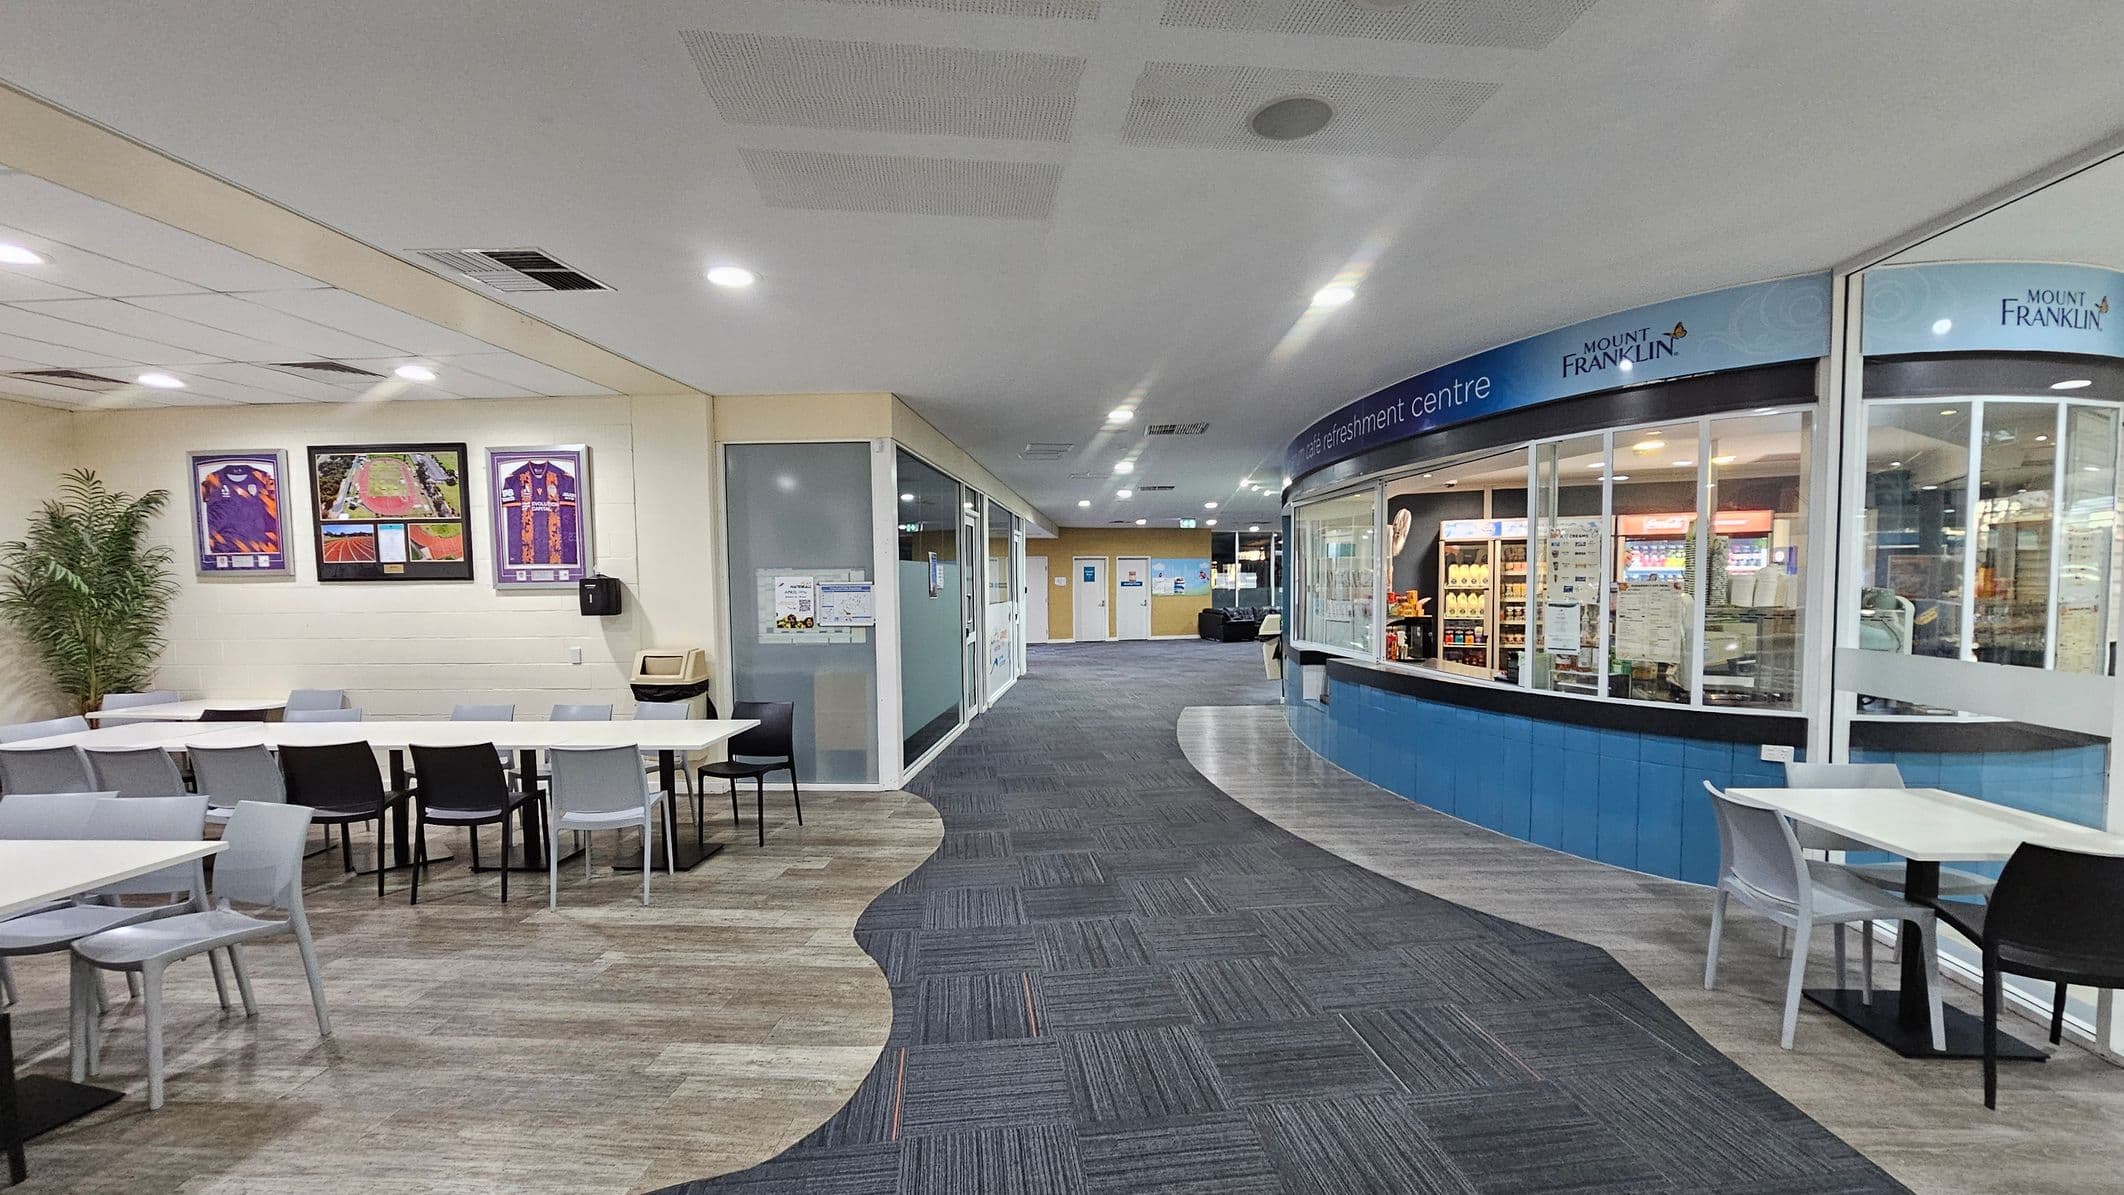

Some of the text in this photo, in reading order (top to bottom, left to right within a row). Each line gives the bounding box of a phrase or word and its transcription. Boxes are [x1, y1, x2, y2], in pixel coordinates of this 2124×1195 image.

[2027, 289, 2086, 306] MOUNT
[2001, 298, 2101, 330] FRANKLIN
[1583, 327, 1650, 355] MOUNT
[1562, 337, 1674, 378] FRANKLIN
[1305, 432, 1321, 460] café
[1323, 398, 1404, 450] refreshment
[1411, 376, 1491, 417] centre
